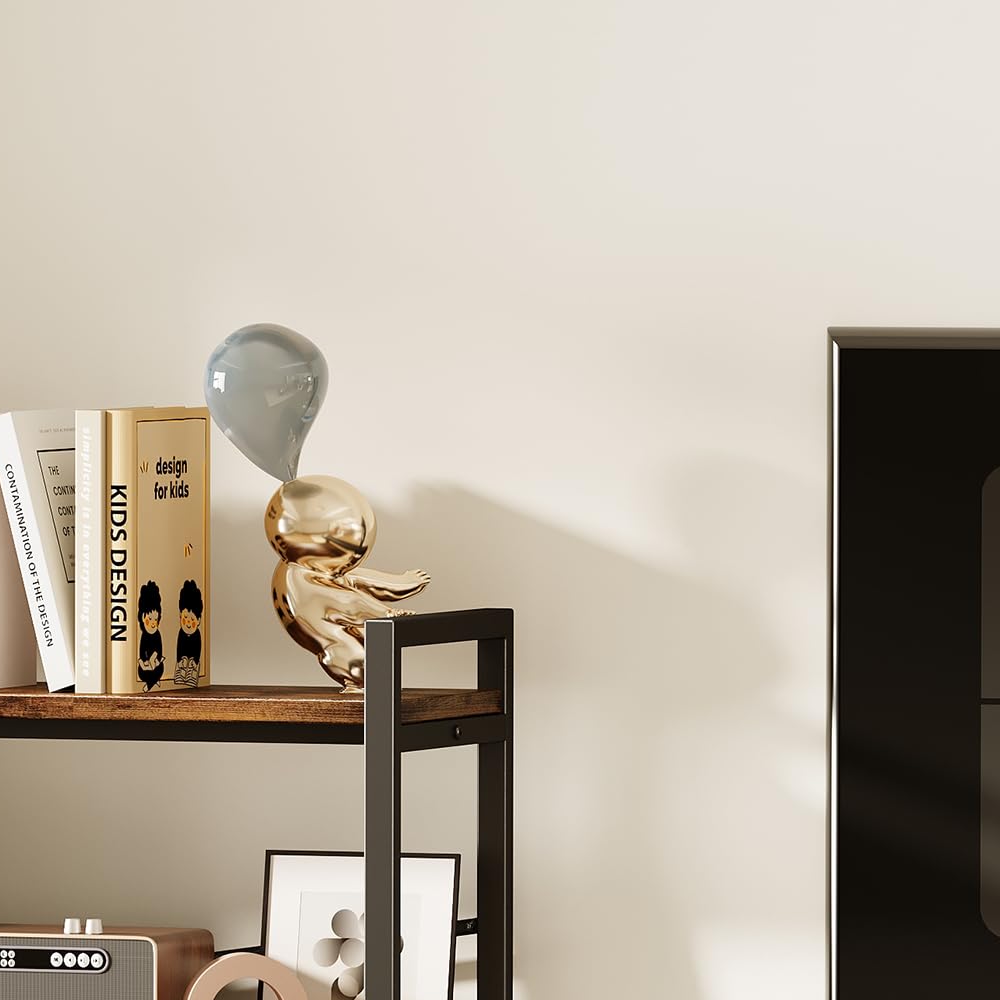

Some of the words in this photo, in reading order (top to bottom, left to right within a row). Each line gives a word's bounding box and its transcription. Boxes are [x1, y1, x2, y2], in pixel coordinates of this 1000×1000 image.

[48, 465, 60, 476] THE
[80, 426, 92, 502] simplicity
[155, 456, 188, 479] design
[154, 482, 168, 500] for
[169, 480, 189, 499] kids
[5, 463, 33, 560] CONTAMINATION
[82, 506, 92, 519] is
[110, 485, 127, 542] KIDS
[82, 523, 92, 539] in
[28, 562, 38, 577] OF
[32, 579, 44, 603] THE
[80, 543, 92, 624] everything
[110, 549, 127, 642] DESIGN
[37, 604, 54, 647] DESIGN
